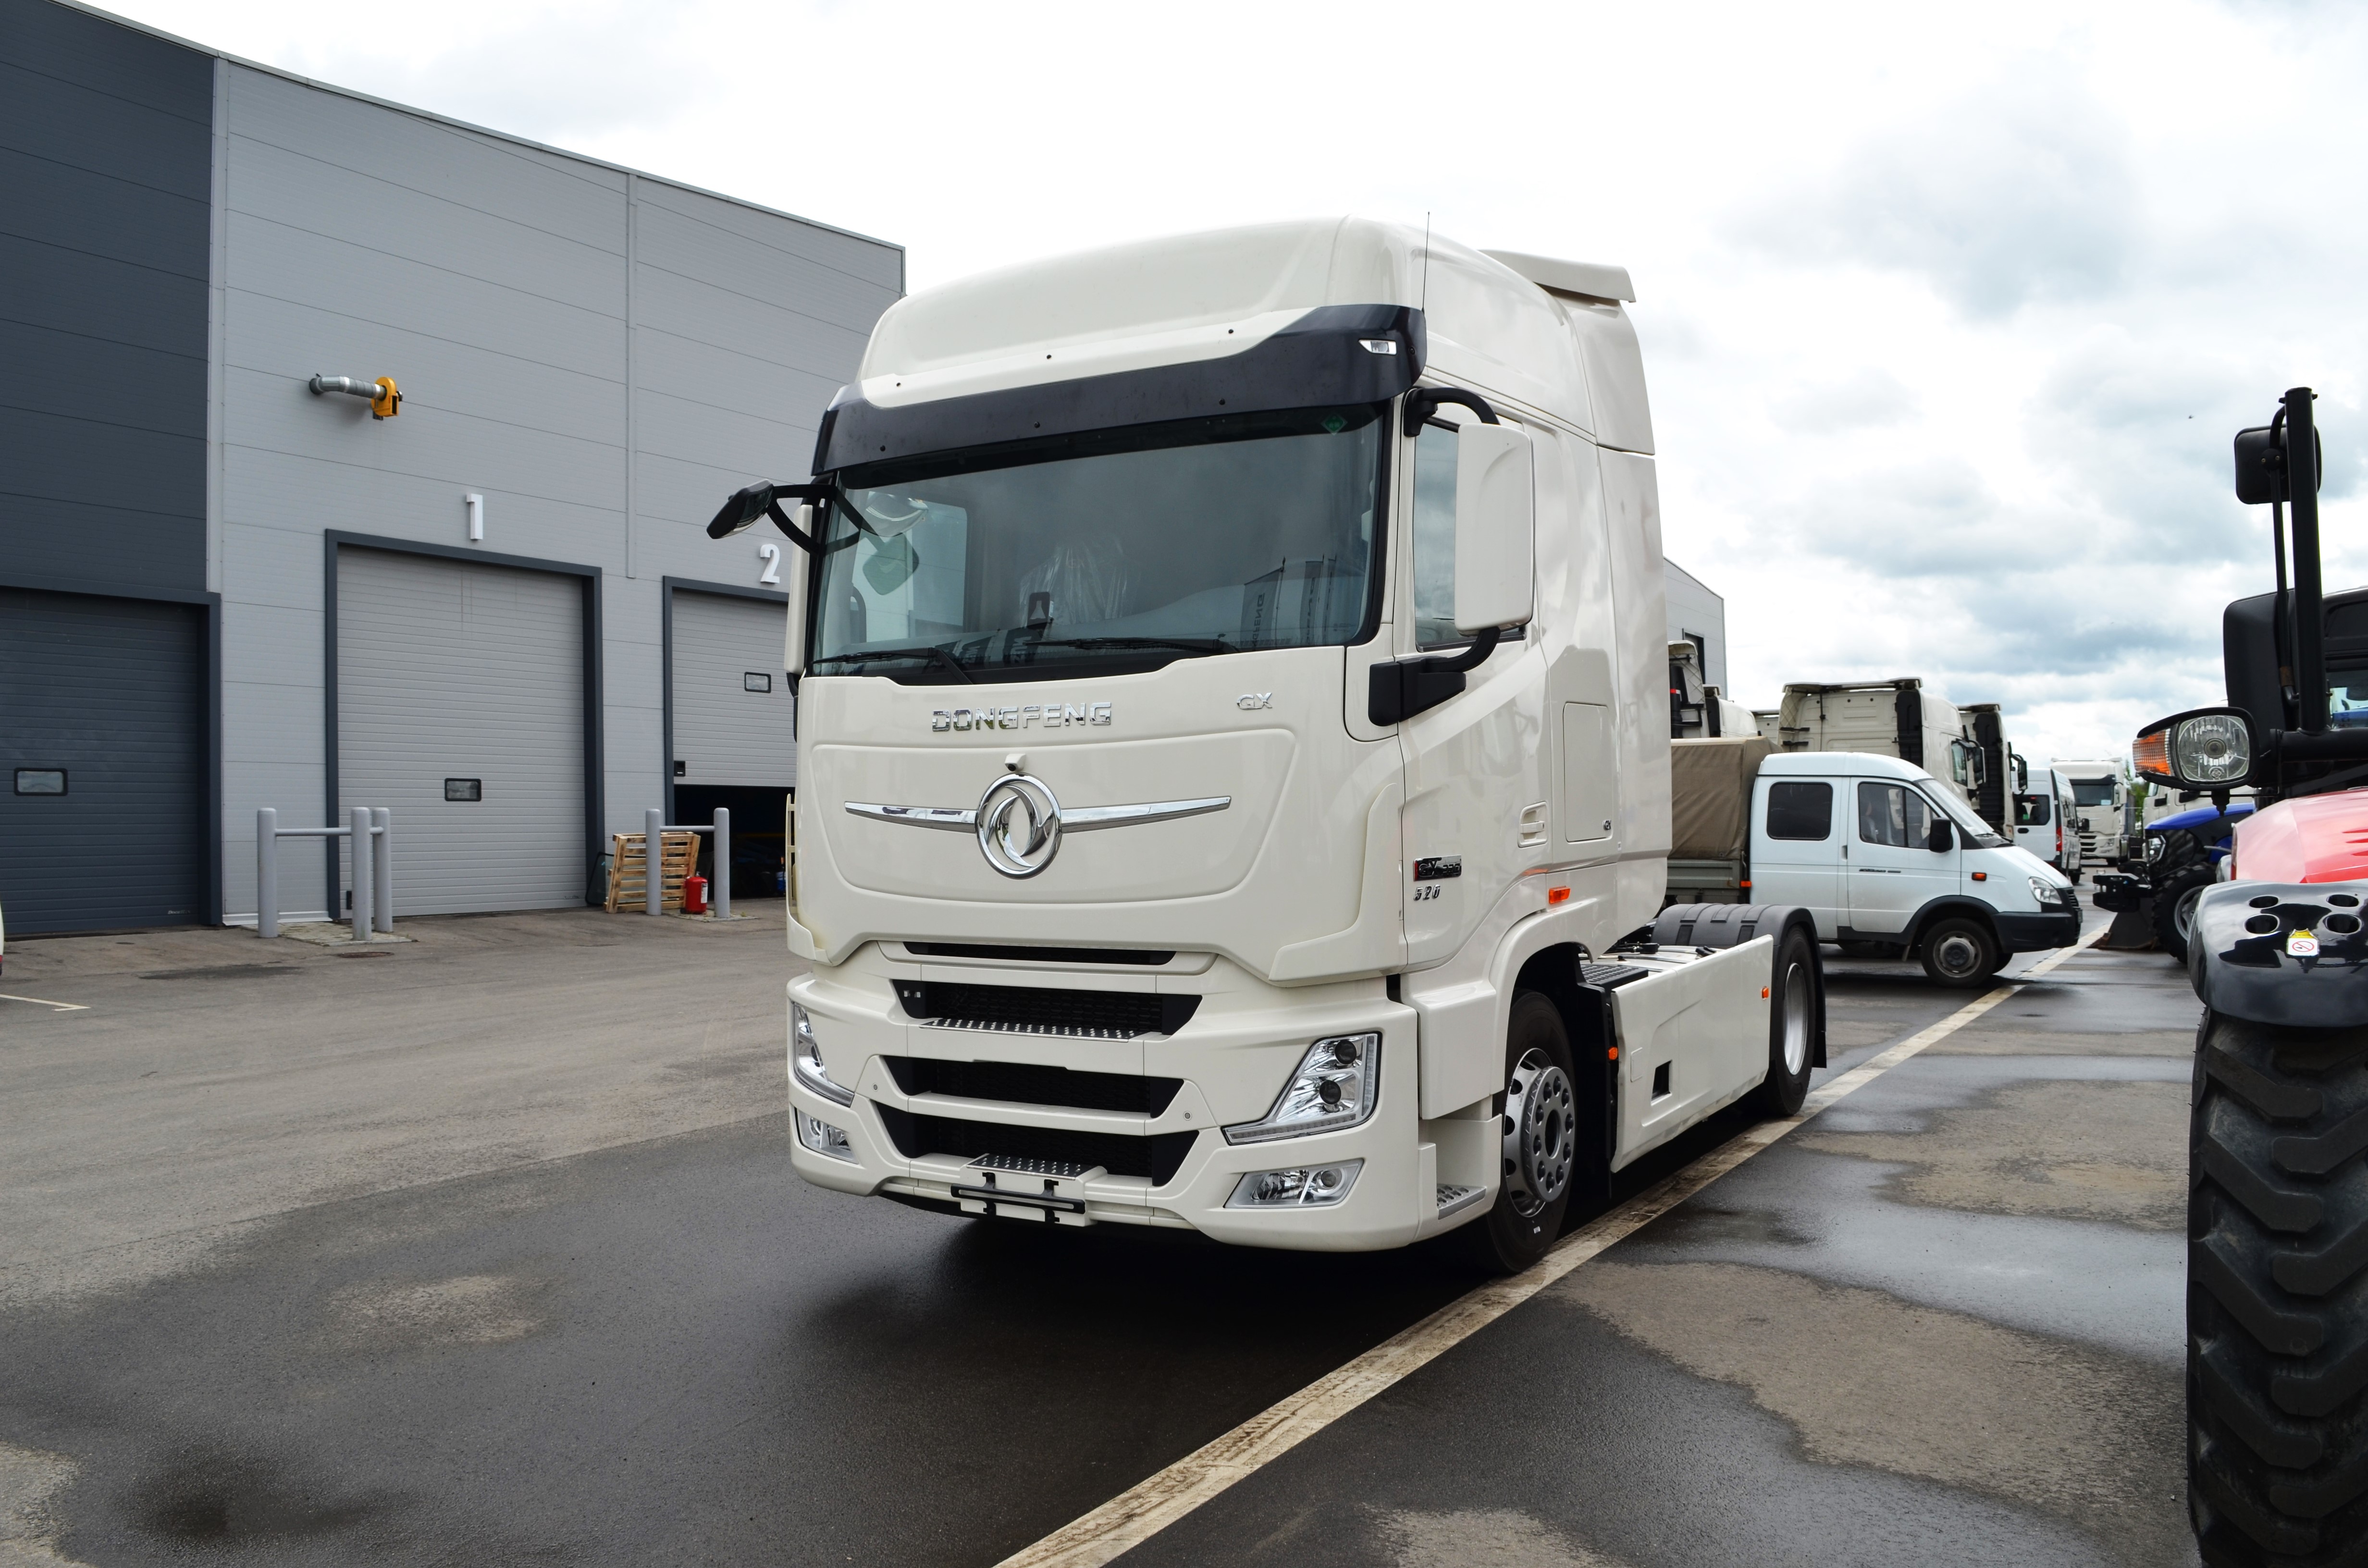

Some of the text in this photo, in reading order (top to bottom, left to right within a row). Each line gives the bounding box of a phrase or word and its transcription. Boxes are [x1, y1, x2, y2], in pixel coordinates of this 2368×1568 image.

[466, 493, 482, 539] 1
[760, 544, 780, 583] 2
[1236, 692, 1272, 710] GX
[932, 702, 1111, 732] DONGFENG
[1418, 860, 1438, 877] GX
[1414, 884, 1440, 901] 520
